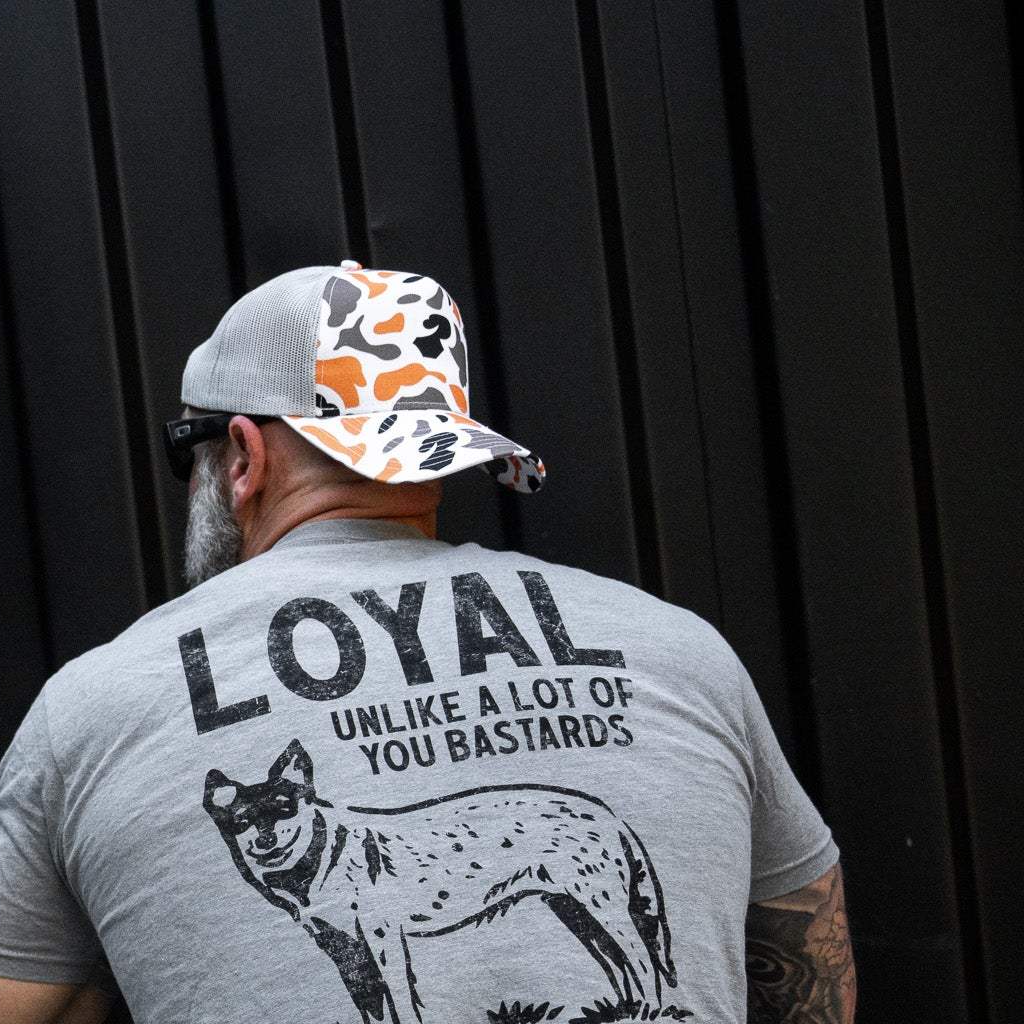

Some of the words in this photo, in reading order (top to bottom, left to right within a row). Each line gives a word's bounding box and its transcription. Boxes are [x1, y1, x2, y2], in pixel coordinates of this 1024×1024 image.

[177, 570, 627, 736] LOYAL
[330, 691, 466, 741] UNLIKE
[479, 685, 502, 717] A
[507, 677, 576, 712] LOT
[588, 676, 633, 709] OF
[358, 735, 436, 776] YOU
[445, 714, 634, 763] BASTARDS
